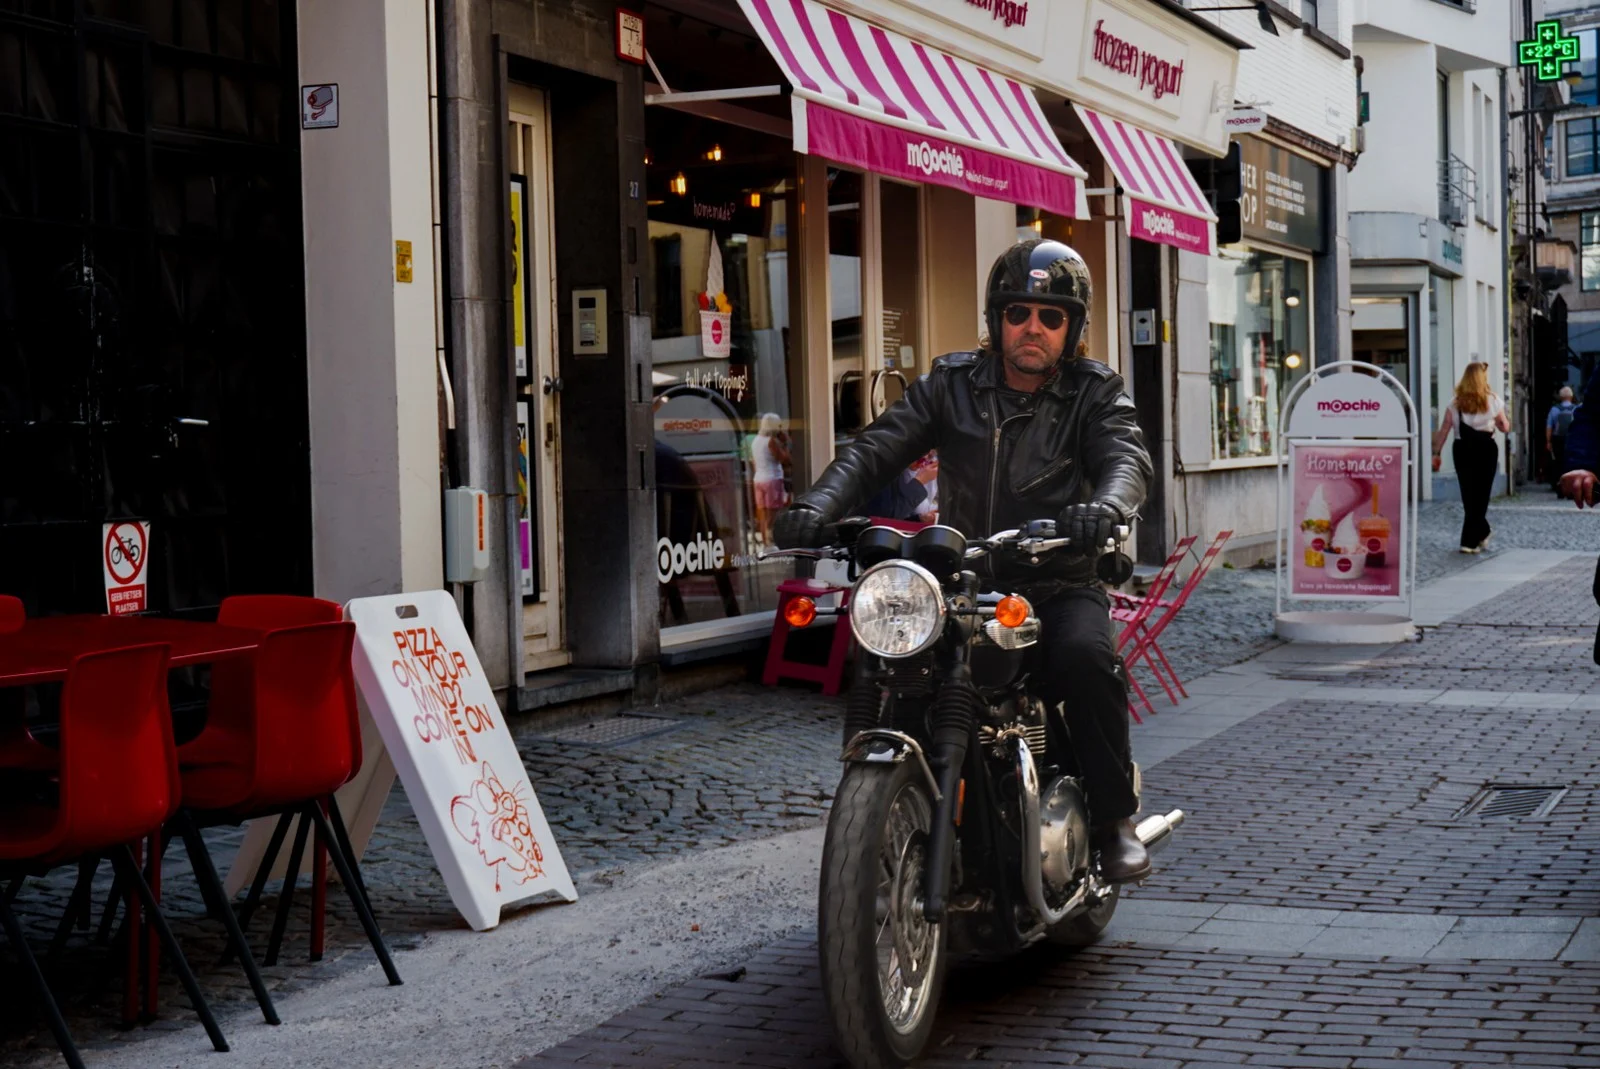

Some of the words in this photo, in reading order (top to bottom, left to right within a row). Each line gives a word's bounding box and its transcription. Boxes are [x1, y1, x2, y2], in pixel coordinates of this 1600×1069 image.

[994, 0, 1028, 27] yogurt
[1094, 19, 1138, 77] frozen
[1140, 51, 1184, 99] yogurt
[1526, 43, 1572, 58] +22°C
[1226, 117, 1261, 126] moochie
[907, 141, 963, 177] moochie
[629, 180, 639, 198] 27
[1241, 162, 1257, 190] HER
[1142, 209, 1175, 236] moochie
[1242, 192, 1257, 225] OP
[685, 368, 700, 389] full
[702, 371, 711, 389] of
[1317, 399, 1381, 413] moochie
[1307, 455, 1384, 472] Homemade
[657, 531, 725, 584] oochie
[393, 627, 447, 658] PIZZA
[392, 657, 422, 688] ON
[419, 651, 471, 683] YOUR
[411, 680, 465, 714] MIND?
[413, 709, 467, 743] COME
[465, 703, 495, 733] ON
